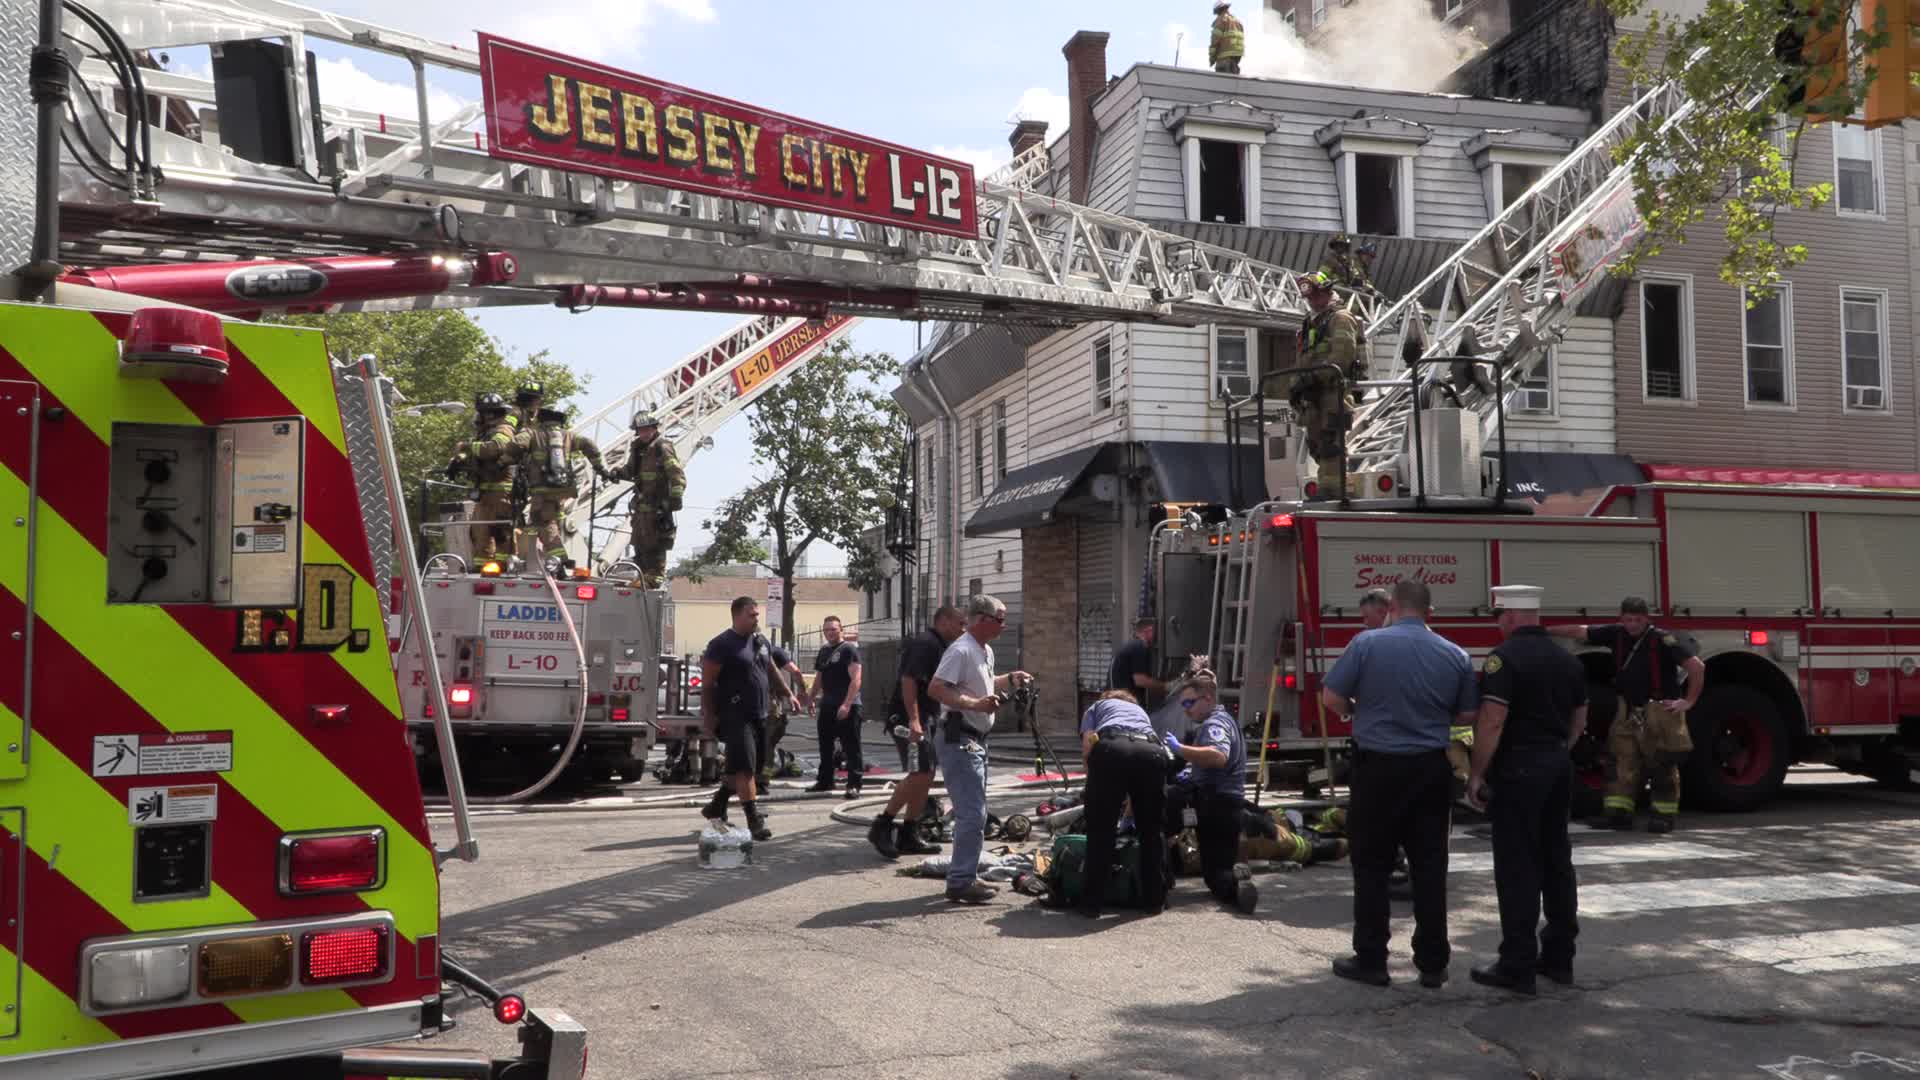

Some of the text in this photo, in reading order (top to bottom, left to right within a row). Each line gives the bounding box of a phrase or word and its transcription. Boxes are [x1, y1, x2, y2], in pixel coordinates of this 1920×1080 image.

[529, 73, 962, 223] JERSEY CITY L-12
[740, 354, 770, 387] L-10
[1354, 554, 1457, 565] SMOKE DETECTORS
[1355, 567, 1403, 589] Save
[497, 604, 562, 621] LADDE
[490, 630, 570, 641] KEEP BACK 500 FEE
[508, 655, 558, 671] L-10
[612, 675, 645, 692] J.C.
